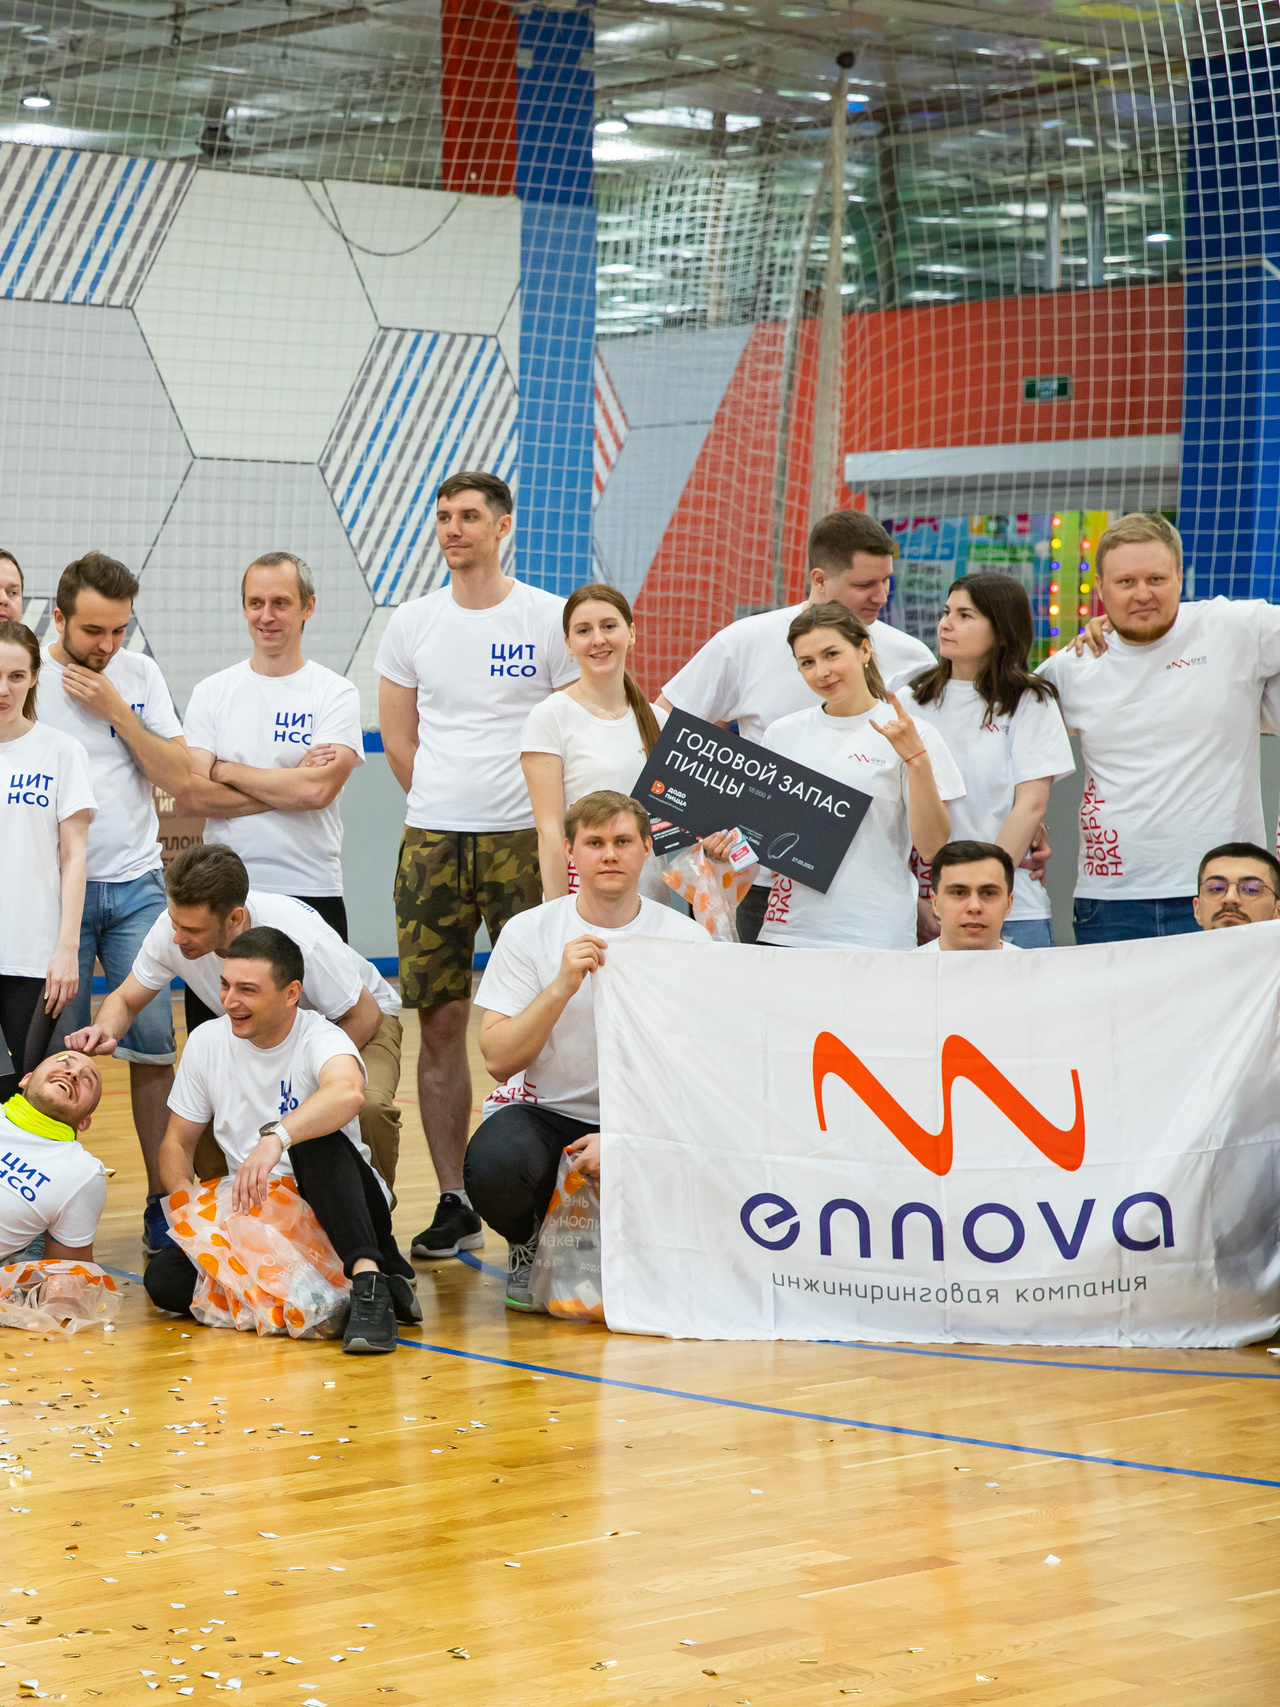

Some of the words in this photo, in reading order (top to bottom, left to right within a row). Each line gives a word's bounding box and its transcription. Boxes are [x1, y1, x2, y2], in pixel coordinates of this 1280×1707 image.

[490, 664, 537, 678] НСО
[491, 643, 536, 662] ЦИТ
[10, 773, 54, 791] ЦИТ
[665, 750, 745, 799] ПИЦЦЫ
[676, 728, 778, 786] ГОДОВОЙ
[778, 774, 851, 818] ЗАПАС
[7, 792, 50, 808] НСО
[1081, 778, 1096, 876] ЭНЕРГИЯ
[1088, 793, 1109, 877] ВОКРУГ
[1104, 829, 1124, 876] НАС
[775, 878, 793, 924] НАС
[0, 1152, 51, 1189] ЦИТ
[740, 1191, 1175, 1263] ennova
[772, 1272, 999, 1305] инжиниринговая
[1016, 1274, 1148, 1303] компания
